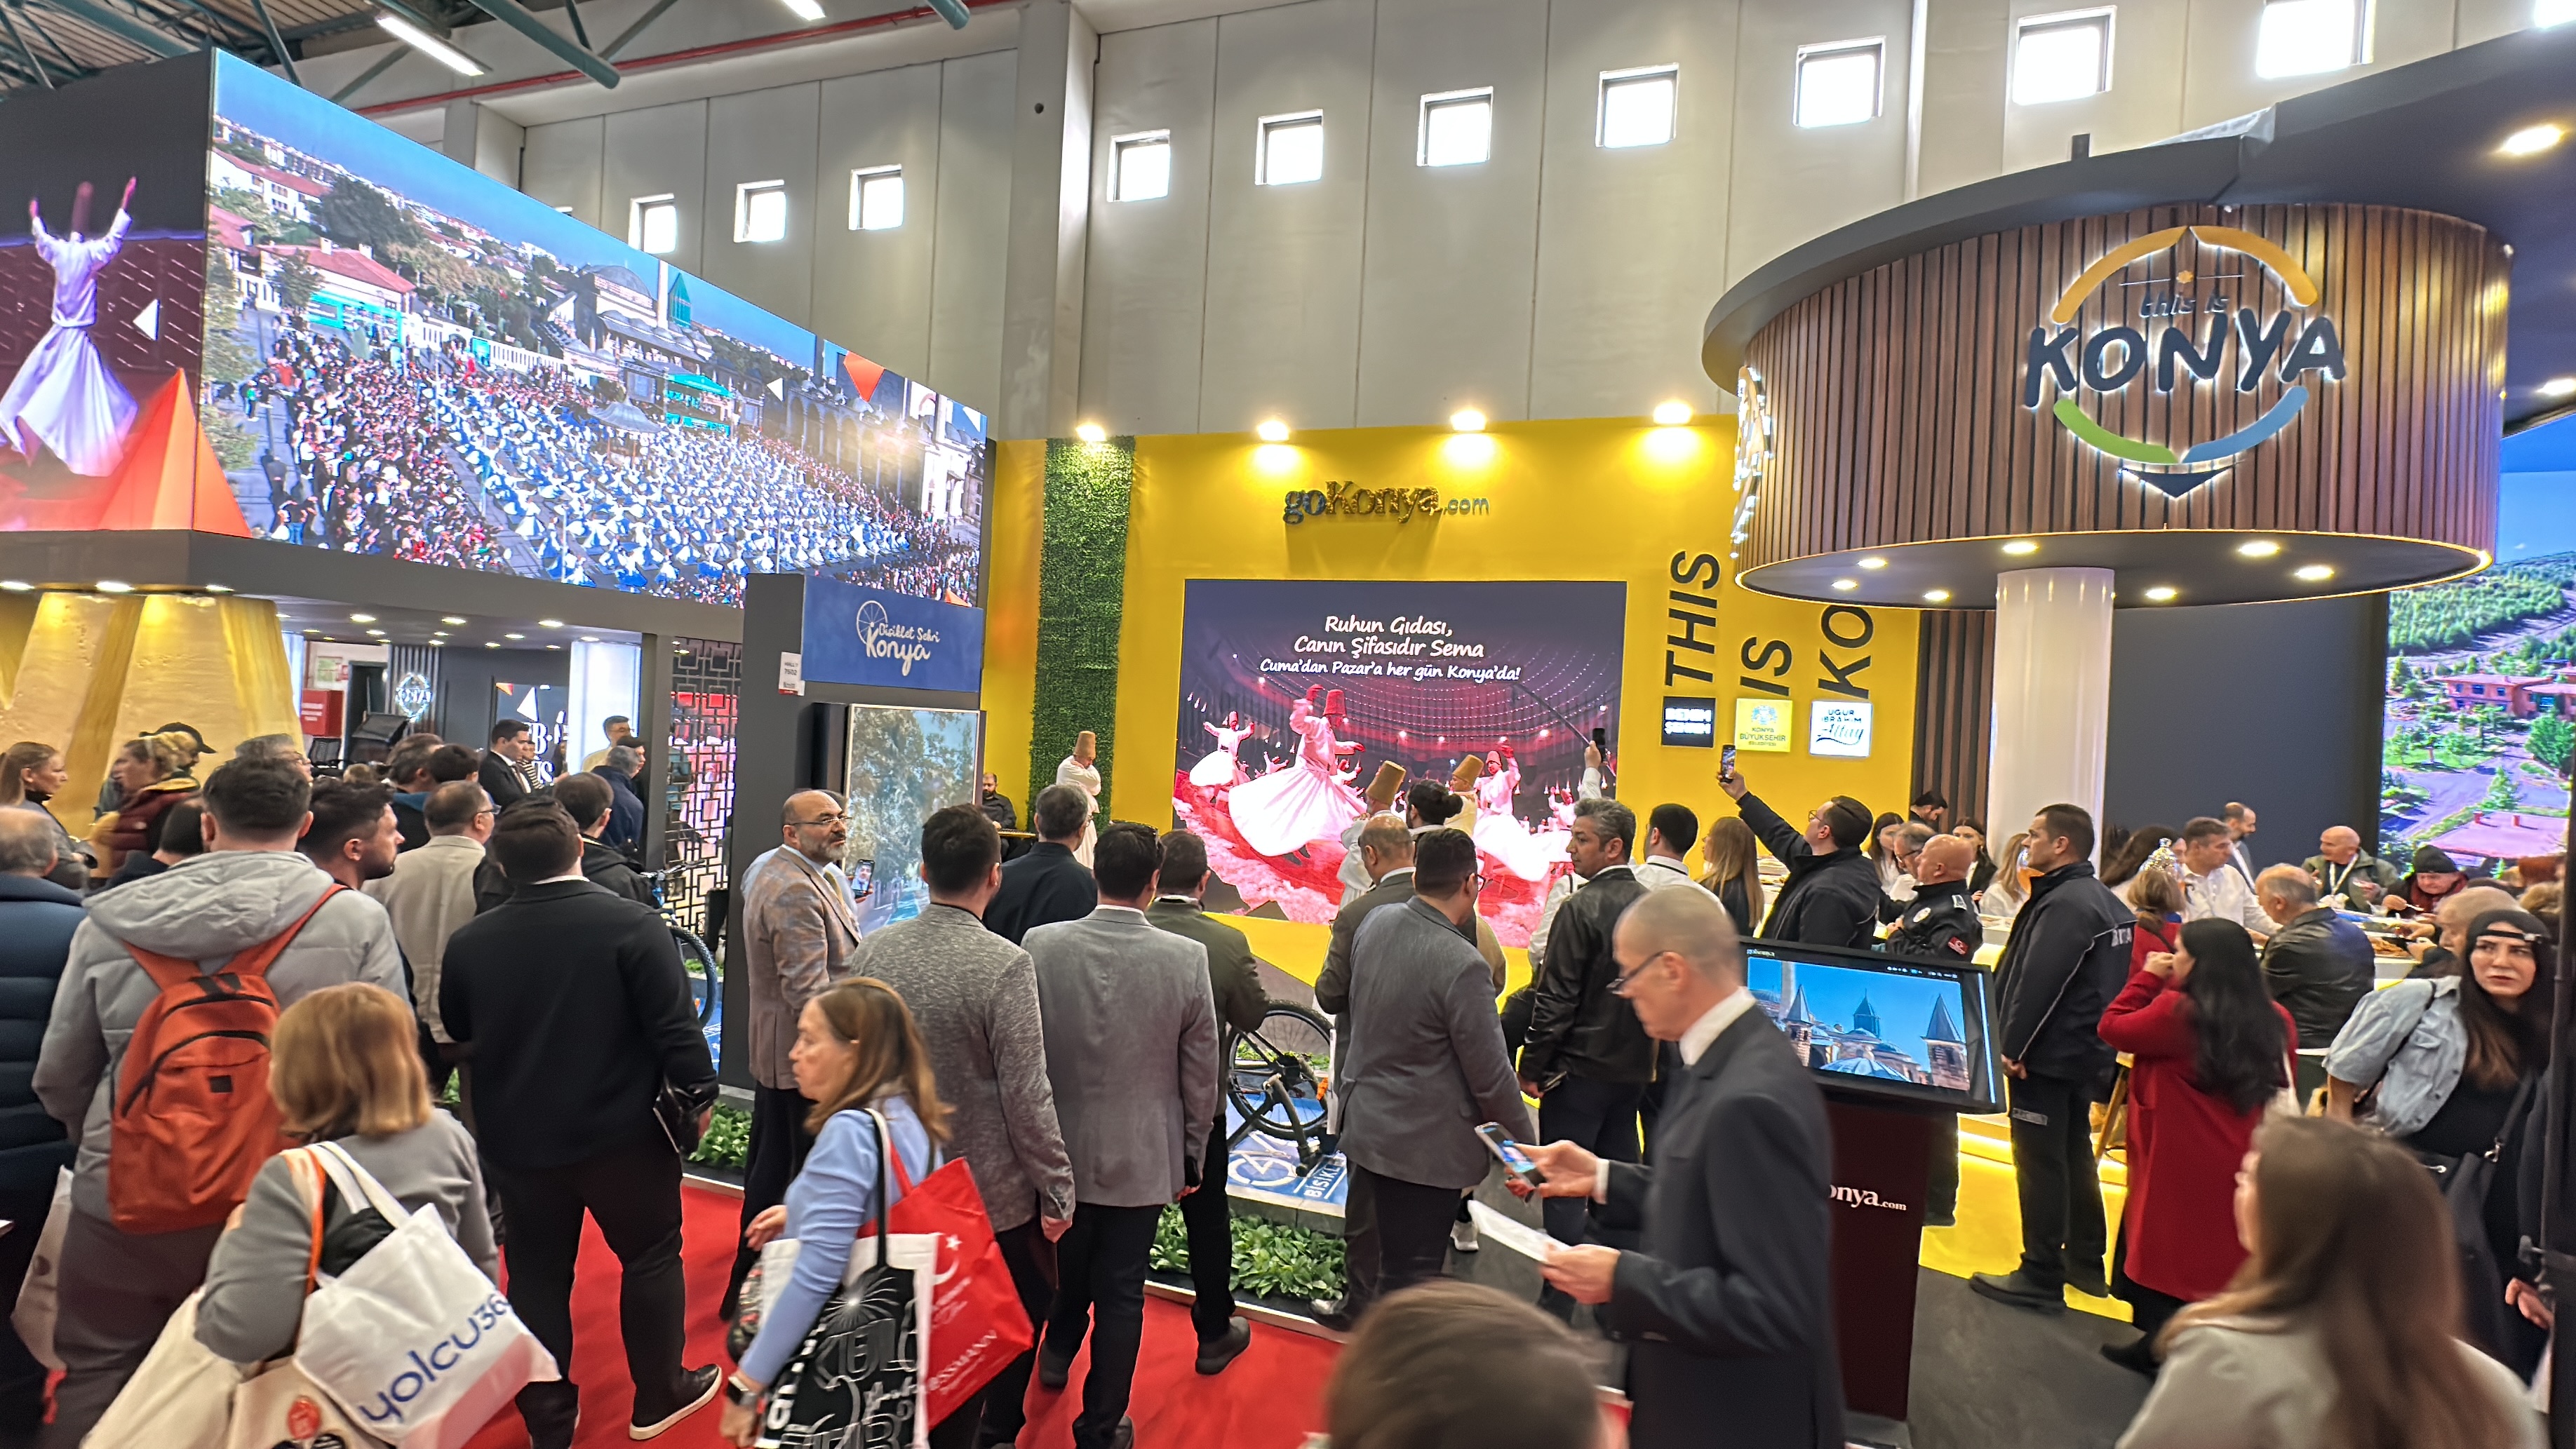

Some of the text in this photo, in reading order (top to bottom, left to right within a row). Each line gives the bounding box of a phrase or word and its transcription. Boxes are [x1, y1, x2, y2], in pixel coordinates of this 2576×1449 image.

[2140, 289, 2229, 318] this is
[2025, 307, 2346, 408] KONYA
[1283, 479, 1489, 524] goKonya.com
[1325, 615, 1453, 636] Ruhun Gıdası,
[1665, 551, 1720, 687] THIS
[866, 626, 931, 676] Konya
[1294, 635, 1484, 658] Canın Şifasıdır Sema
[1740, 636, 1792, 696] IS
[1260, 658, 1521, 684] Cuma'dan Pazar'a her gün Konya'da!
